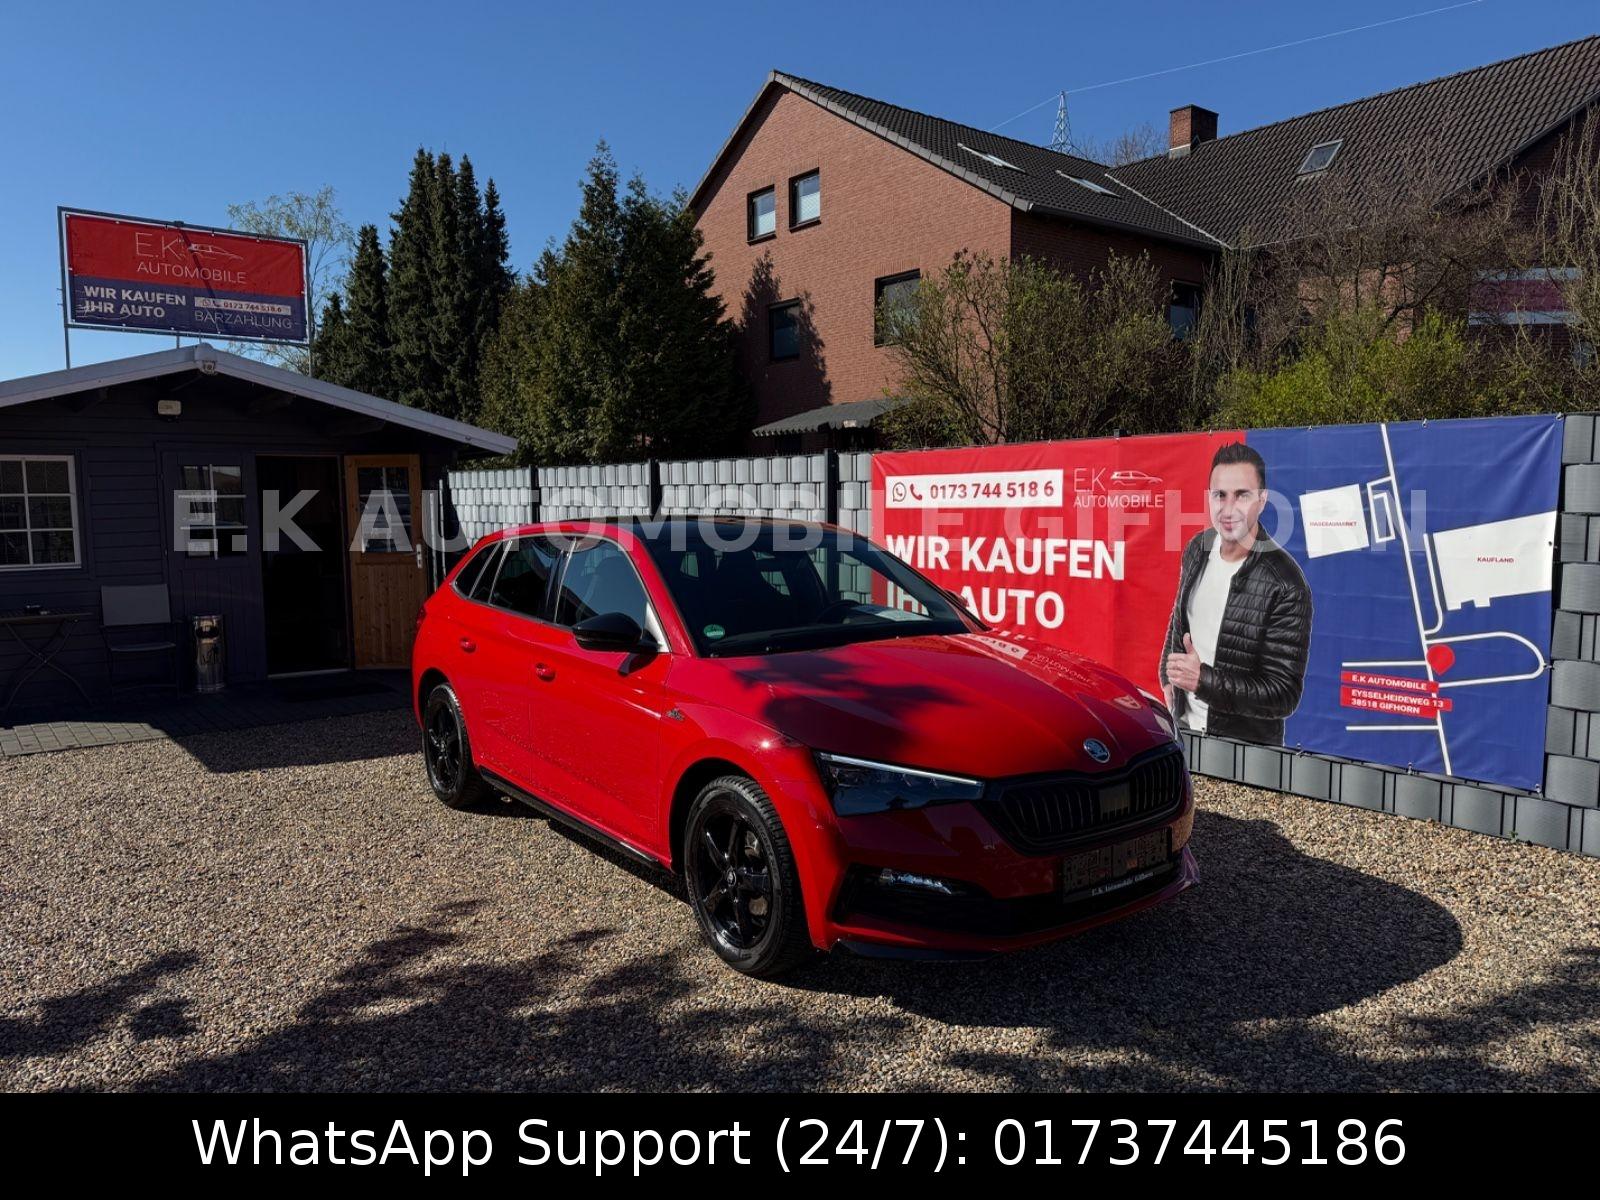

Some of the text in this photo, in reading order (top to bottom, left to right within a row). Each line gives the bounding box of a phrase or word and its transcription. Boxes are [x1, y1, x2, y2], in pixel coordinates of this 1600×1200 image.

[135, 232, 186, 260] E.K
[136, 261, 248, 284] AUTOMOBILE
[84, 285, 187, 306] WIR KAUFEN
[85, 300, 166, 318] IHR AUTO
[223, 302, 244, 310] 0173
[194, 309, 292, 329] BARZAHLUNG
[930, 480, 1055, 499] 0173 744 518 6
[1073, 468, 1107, 493] E.K
[1073, 494, 1165, 509] AUTOMOBILE
[886, 534, 1126, 581] WIR KAUFEN
[1476, 556, 1515, 564] KAUFLAND
[960, 585, 1066, 629] AUTO
[1351, 674, 1428, 690] E.K AUTOMOBILE
[1351, 689, 1444, 708] EYSSELHEIDEWEG 13
[1351, 698, 1420, 714] 38518 GIFHORN
